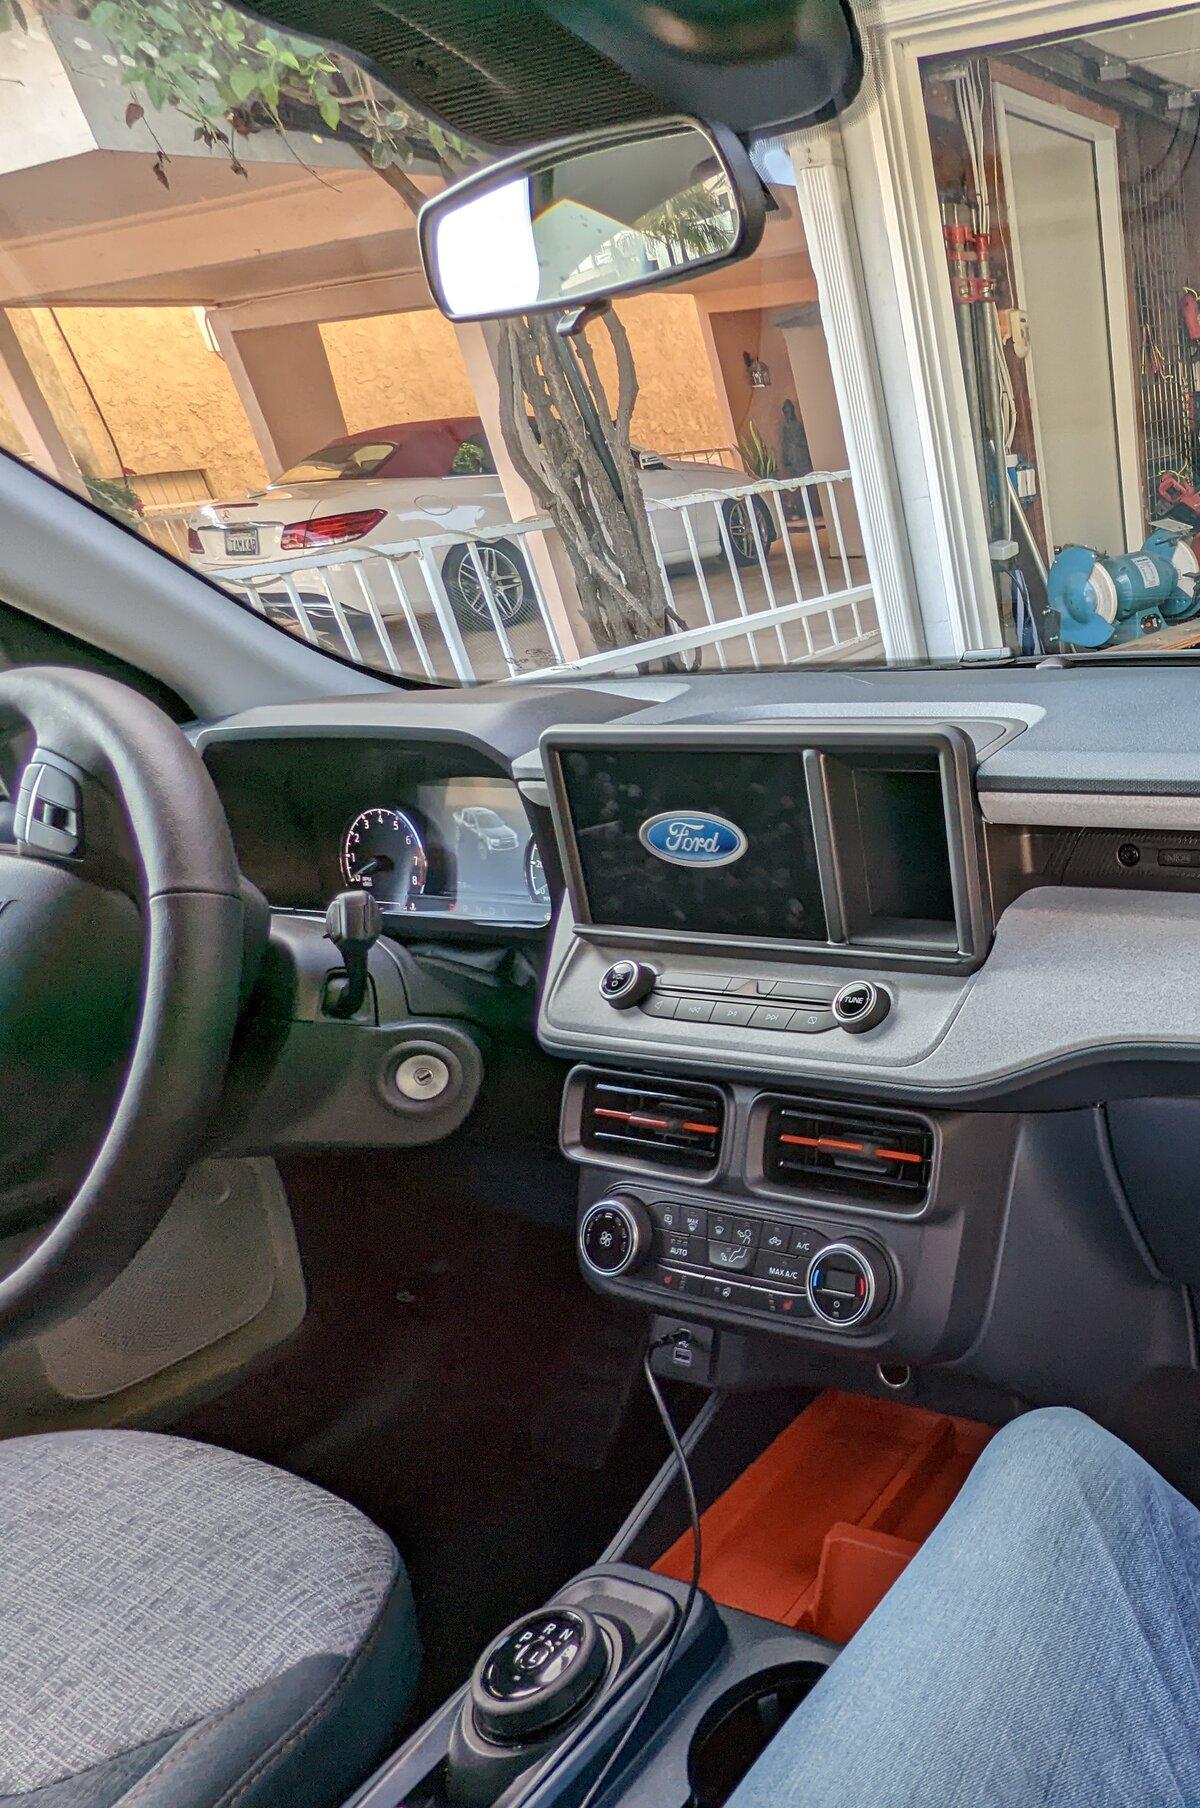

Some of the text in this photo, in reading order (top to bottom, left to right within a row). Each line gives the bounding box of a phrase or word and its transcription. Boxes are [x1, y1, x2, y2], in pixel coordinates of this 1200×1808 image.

[363, 820, 370, 830] 3
[393, 820, 399, 831] 5
[354, 833, 360, 843] 2
[405, 835, 412, 845] 6
[665, 821, 721, 853] Ford
[412, 875, 418, 886] 8
[844, 996, 865, 1005] TUNE
[670, 1246, 688, 1257] AUTO
[796, 1241, 810, 1251] A/C
[769, 1266, 798, 1280] MAX A/C
[542, 1622, 557, 1635] R
[519, 1631, 534, 1643] P
[559, 1628, 574, 1641] N
[528, 1651, 540, 1664] L
